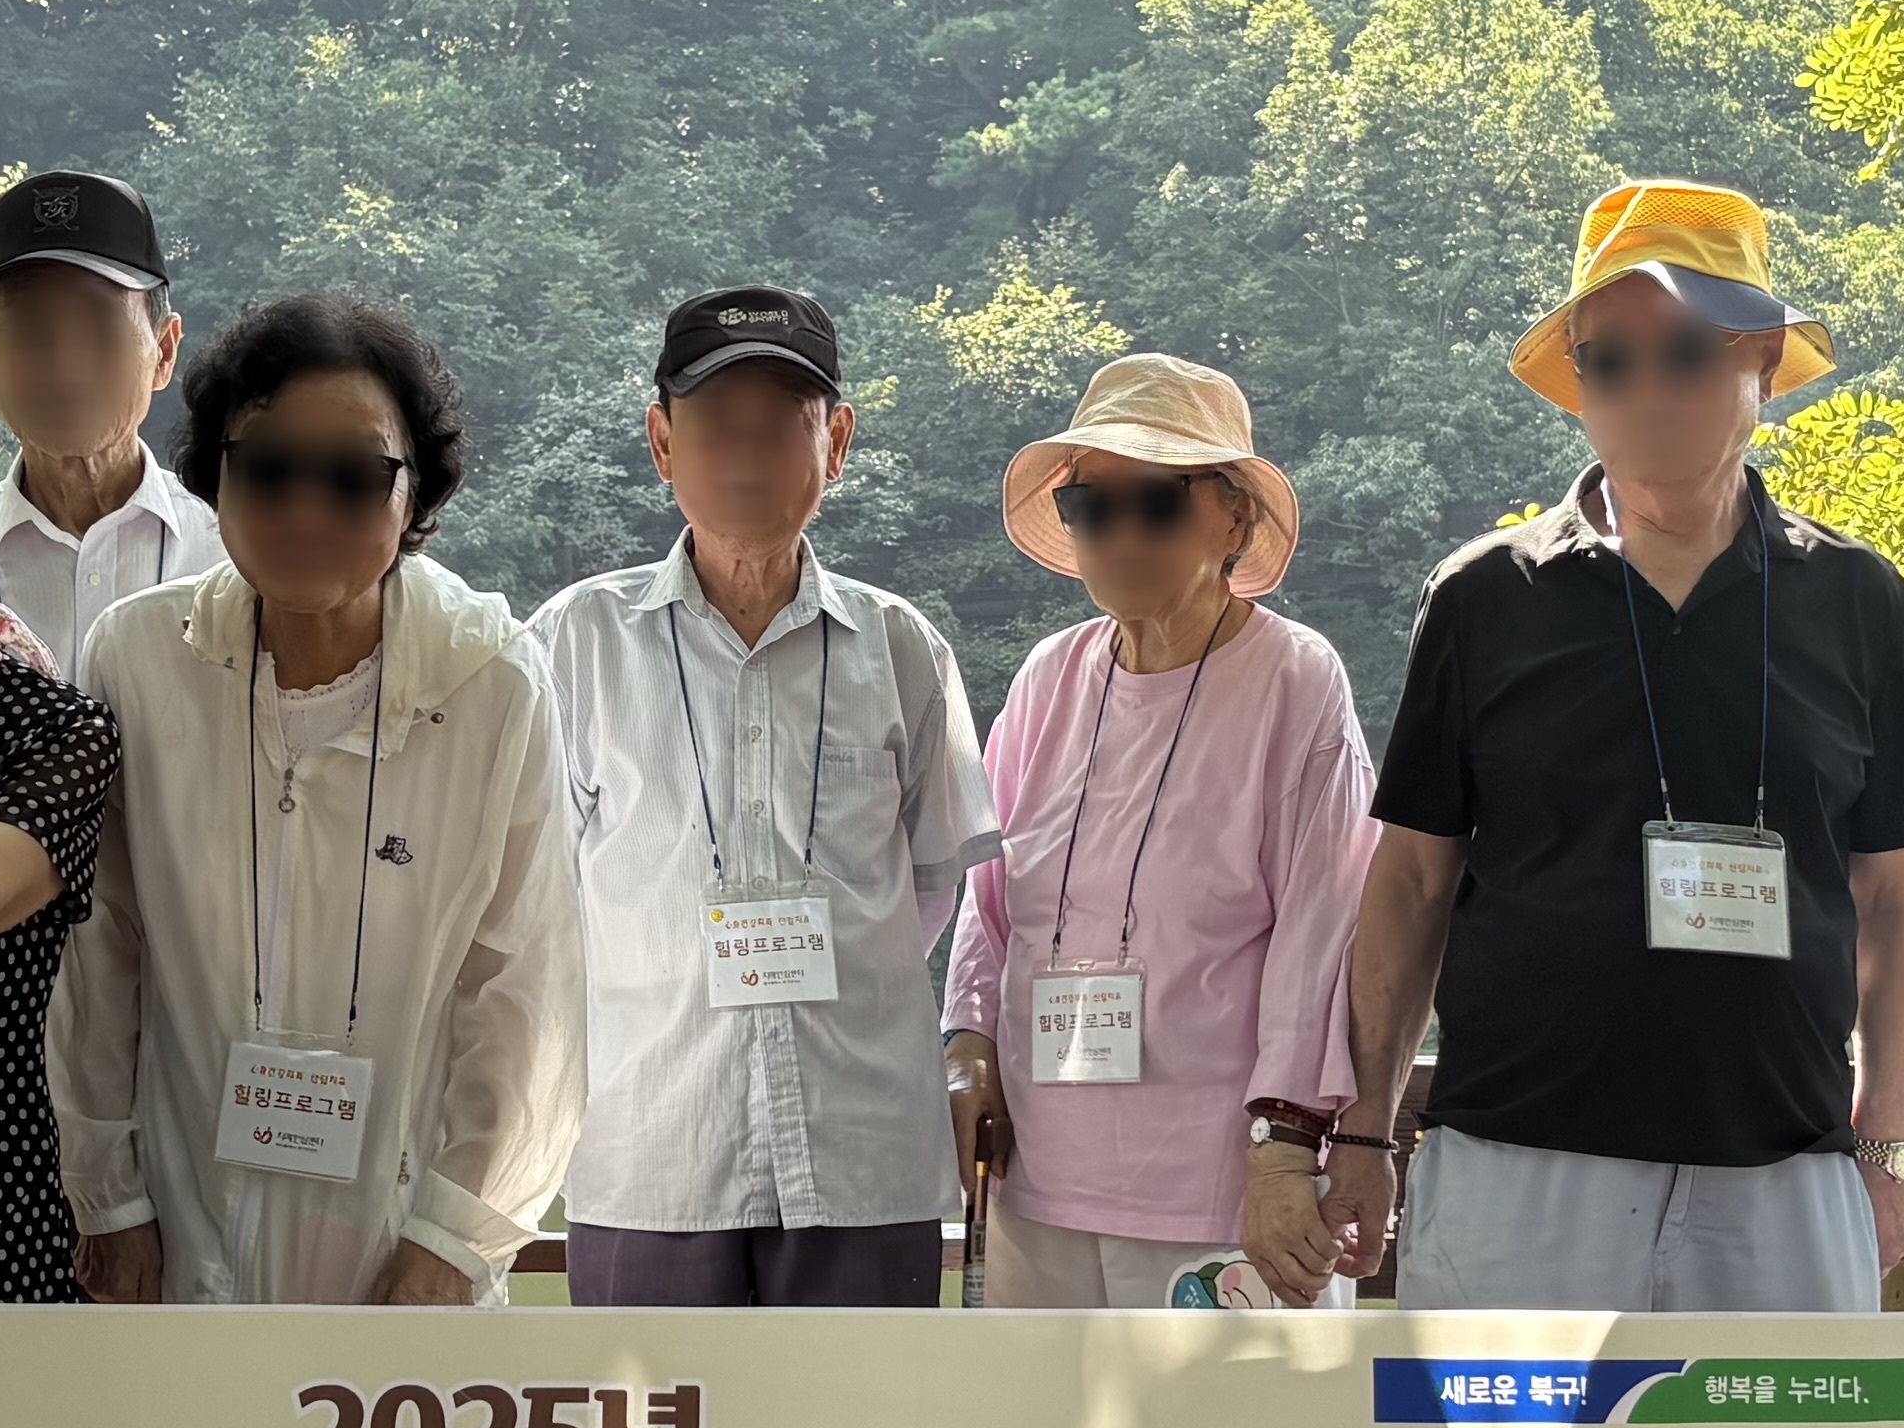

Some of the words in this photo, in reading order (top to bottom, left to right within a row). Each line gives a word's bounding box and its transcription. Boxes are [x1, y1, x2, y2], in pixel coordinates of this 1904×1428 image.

[1659, 877, 1777, 904] 힐링프로그램
[714, 933, 826, 958] 힐링프로그램
[1039, 1011, 1132, 1032] 힐링프로그램
[234, 1084, 357, 1121] 힐링프로그램
[1441, 1375, 1519, 1406] 새로운
[1528, 1375, 1588, 1406] 북구!
[1705, 1375, 1778, 1405] 행복을
[1787, 1375, 1870, 1405] 누리다.
